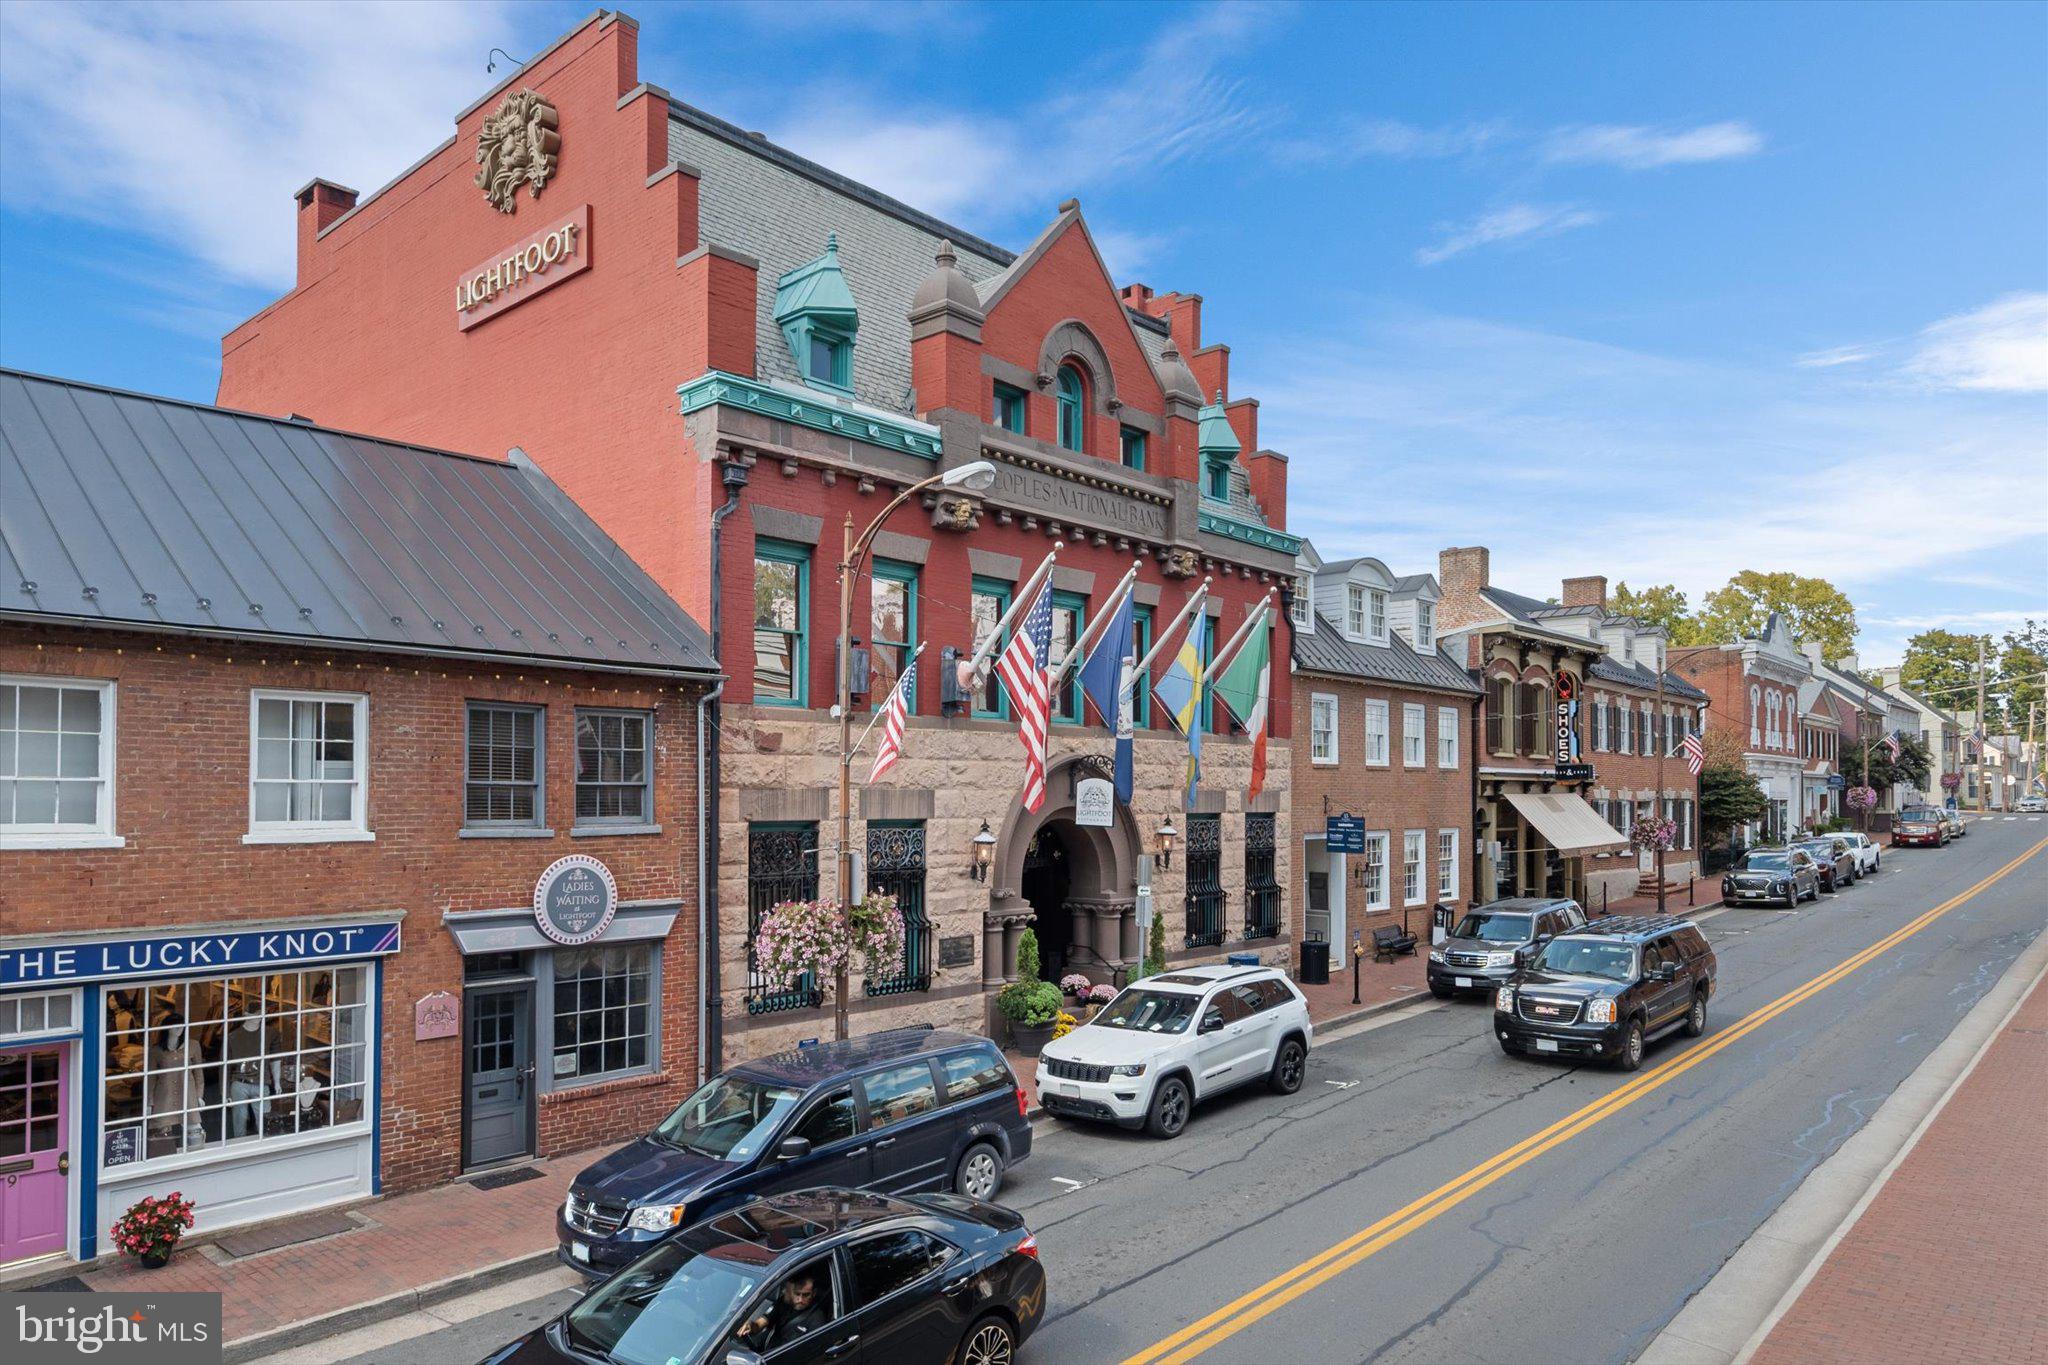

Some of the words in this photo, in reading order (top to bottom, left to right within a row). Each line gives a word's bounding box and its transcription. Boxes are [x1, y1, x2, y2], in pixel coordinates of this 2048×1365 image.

[456, 222, 578, 312] LIGHTFOOT
[994, 469, 1051, 502] EOPLES
[1058, 485, 1127, 522] NATIONAL
[1558, 704, 1568, 762] SHOES
[556, 894, 600, 906] WAITING
[102, 938, 239, 971] LUCKY
[1536, 1006, 1560, 1014] GMC
[108, 1155, 131, 1165] OPEN
[7, 1174, 17, 1189] 9
